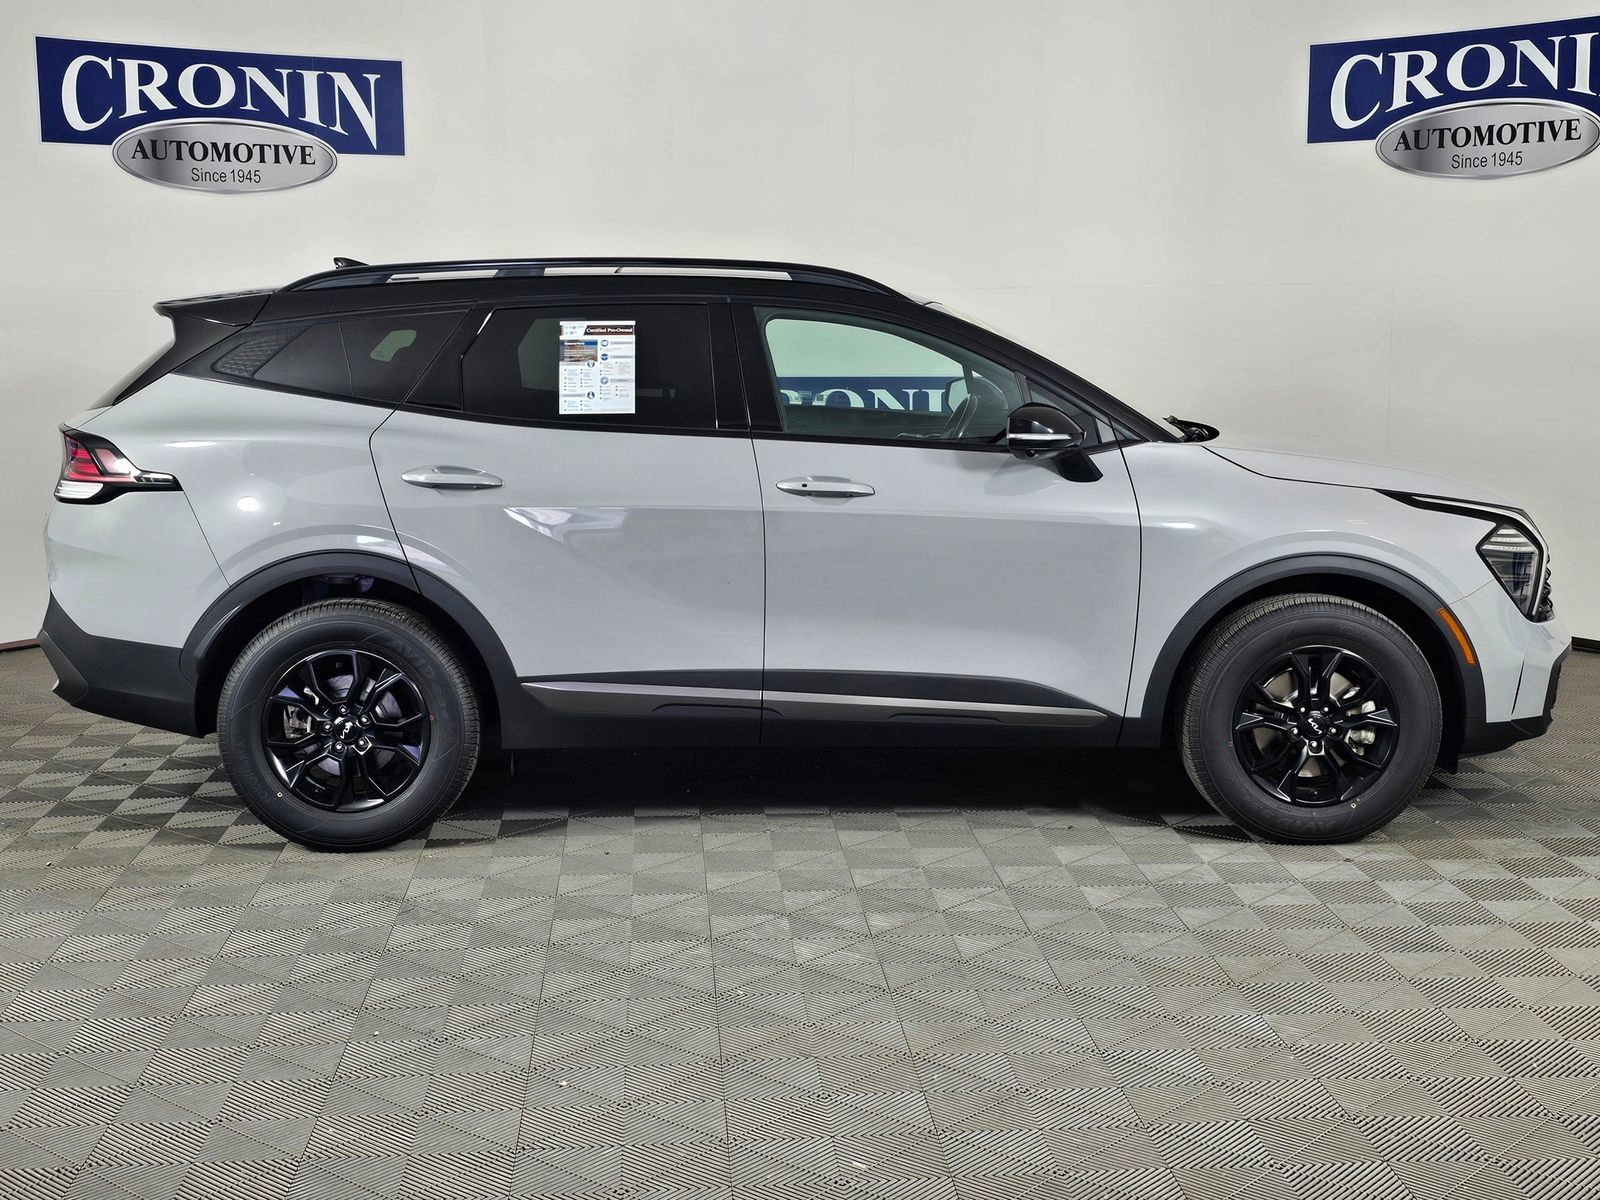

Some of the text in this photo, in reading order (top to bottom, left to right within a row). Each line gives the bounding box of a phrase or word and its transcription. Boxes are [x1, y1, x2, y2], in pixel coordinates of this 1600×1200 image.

[1330, 32, 1600, 130] CRONI
[61, 54, 381, 150] CRONIN
[1393, 118, 1582, 151] AUTOMOTIVE
[131, 138, 316, 165] AUTOMOTIVE
[1451, 151, 1523, 170] Since 1945
[191, 167, 261, 184] Since 1945
